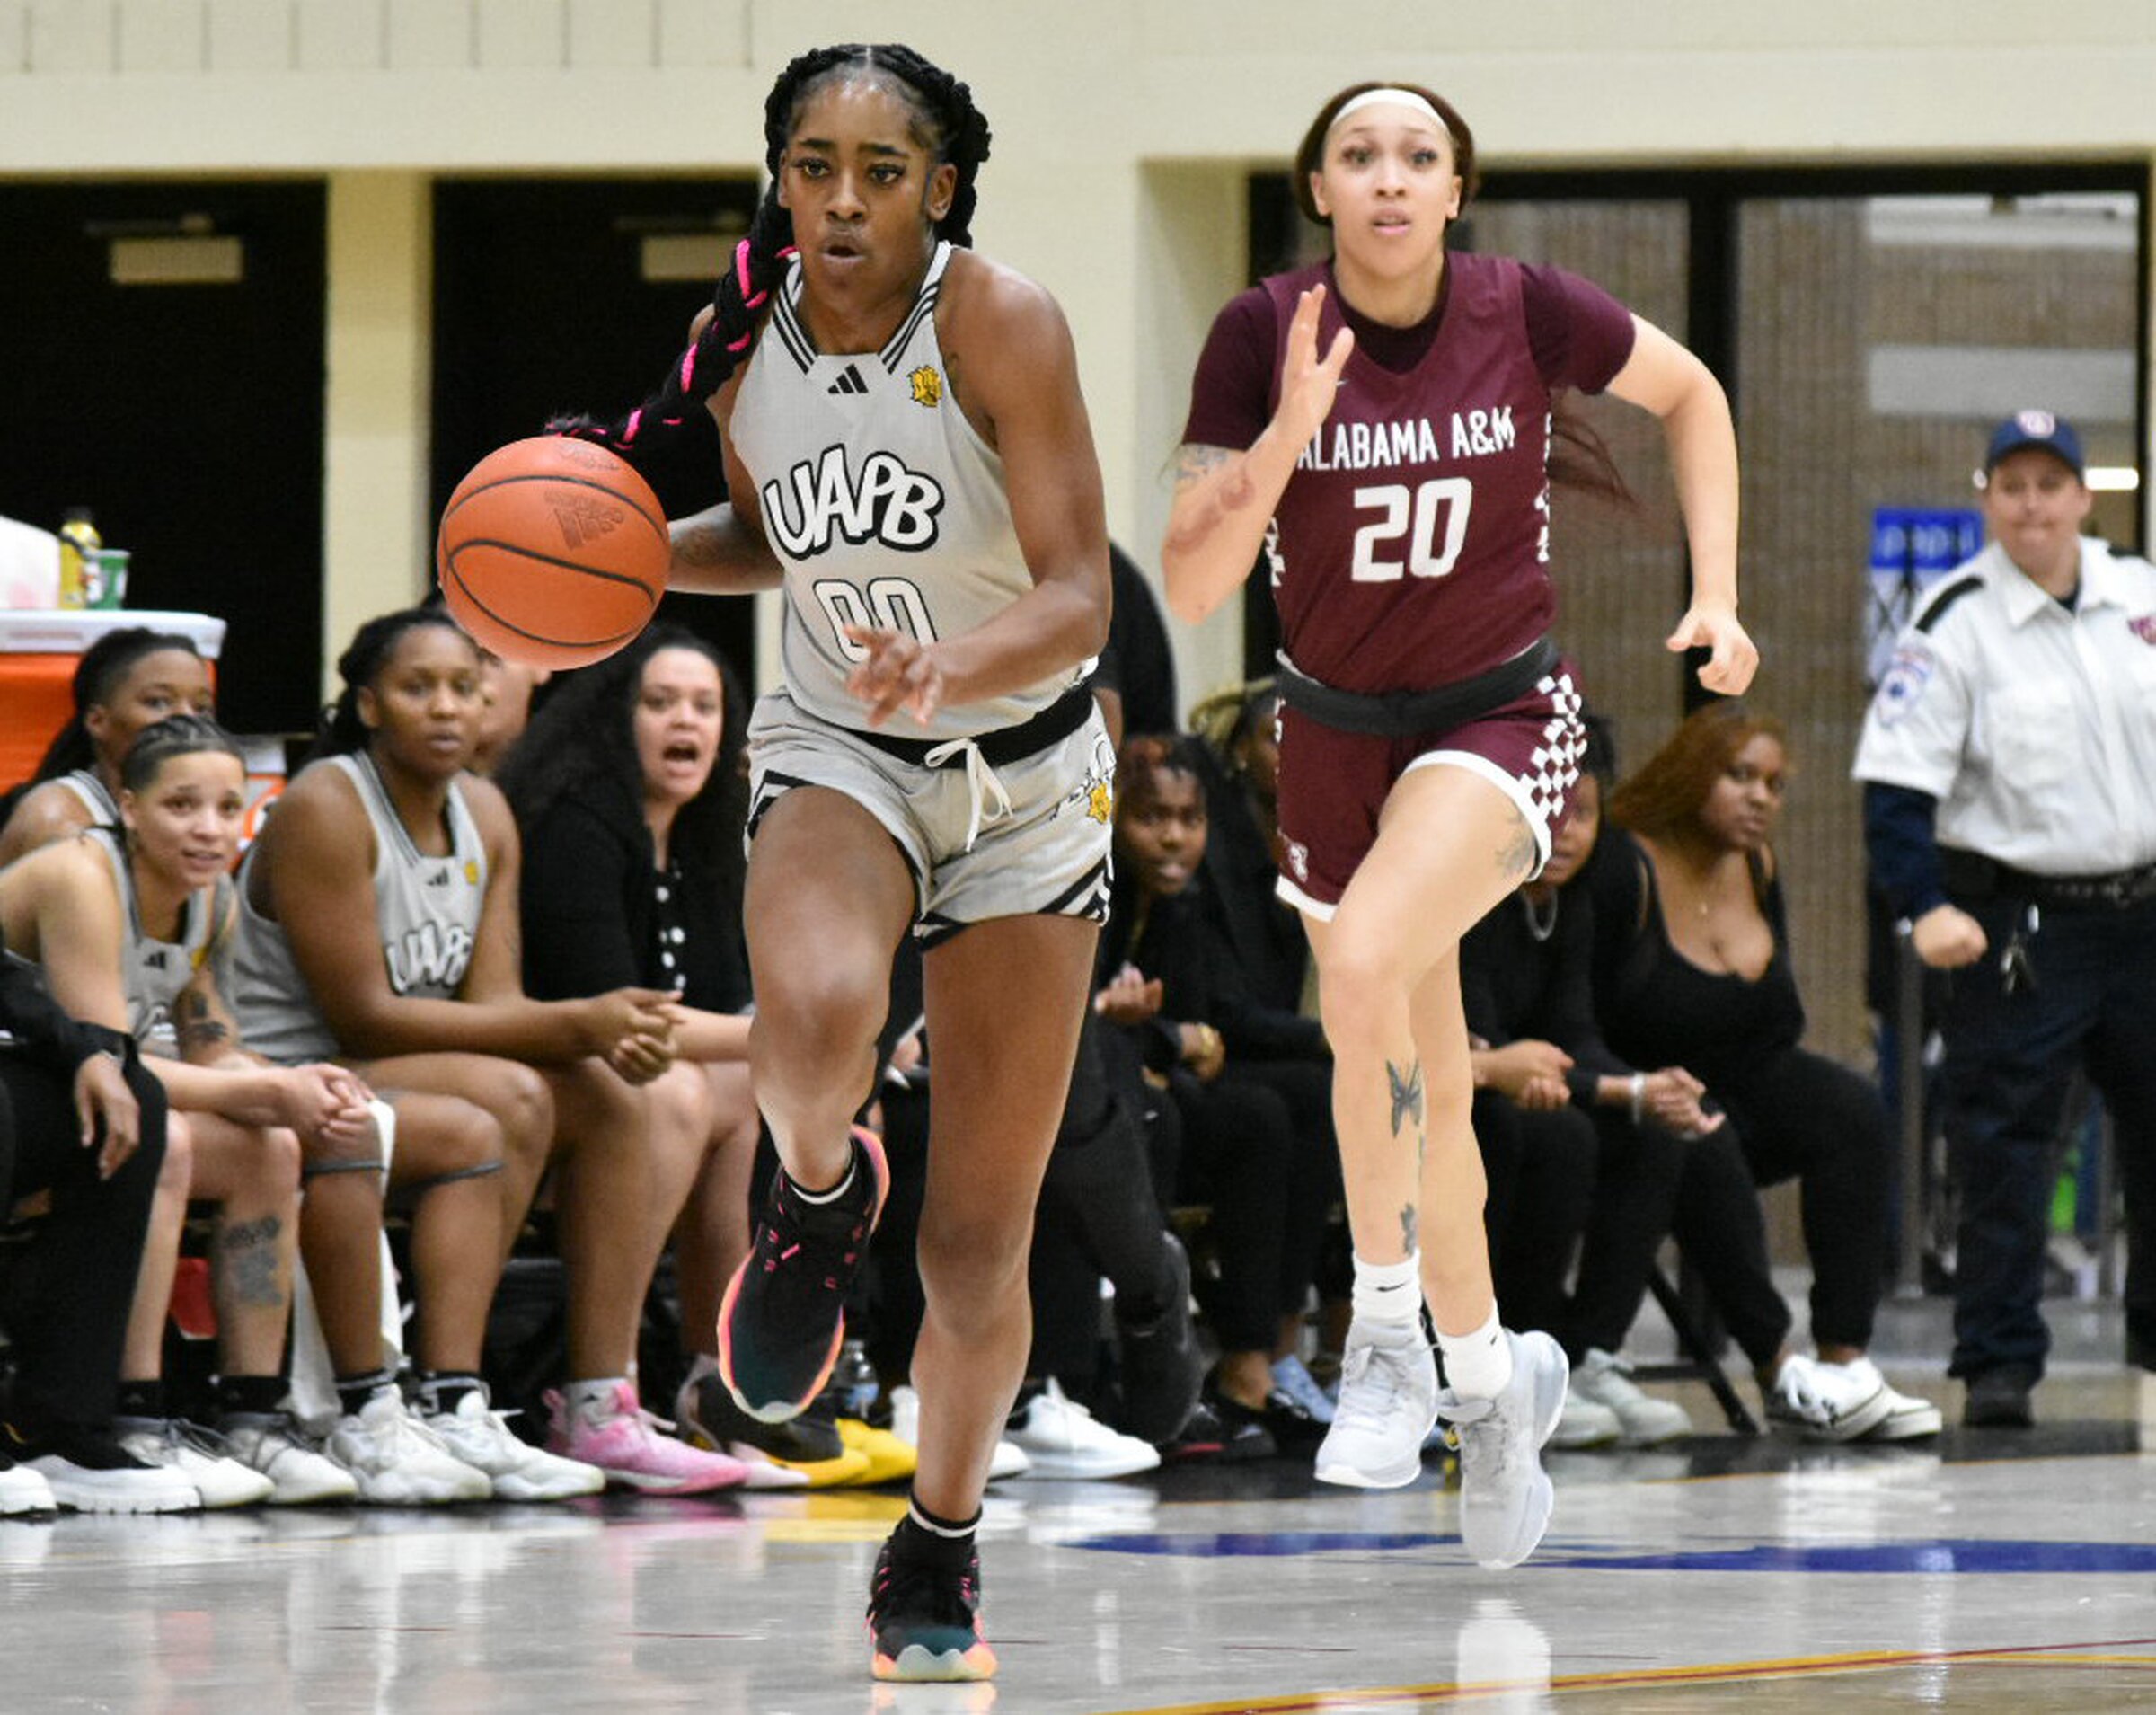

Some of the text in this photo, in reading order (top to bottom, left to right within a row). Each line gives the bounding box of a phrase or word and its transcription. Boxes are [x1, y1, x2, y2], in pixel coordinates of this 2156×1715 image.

[1451, 405, 1515, 459] A&M
[764, 444, 945, 560] UAPB
[1351, 477, 1473, 582] 20
